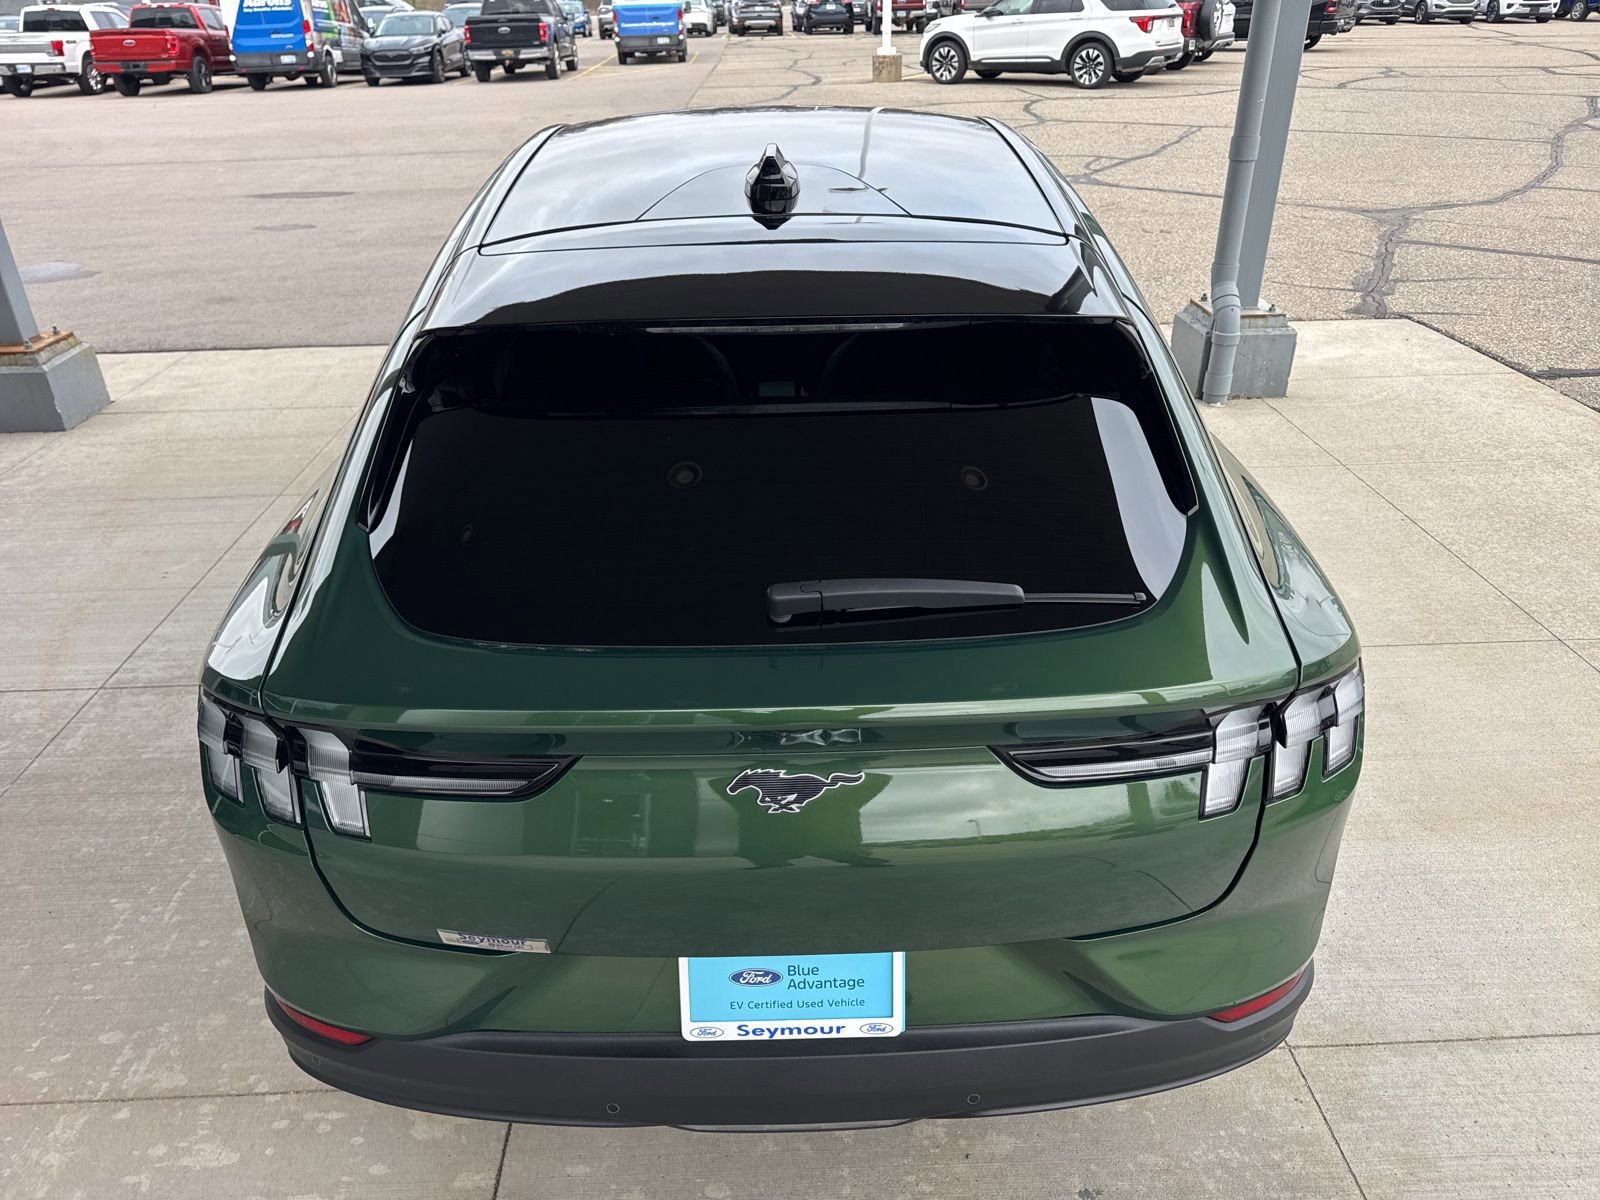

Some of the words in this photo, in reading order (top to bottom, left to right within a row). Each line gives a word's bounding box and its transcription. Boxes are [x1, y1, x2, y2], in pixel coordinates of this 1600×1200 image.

[740, 970, 772, 984] Ford
[787, 964, 820, 977] Blue
[787, 978, 866, 991] Advantage
[730, 1001, 744, 1010] EV
[747, 1000, 793, 1010] Certified
[796, 999, 824, 1009] Used
[827, 997, 866, 1008] Vehicle
[696, 1028, 717, 1037] Ford
[737, 1023, 847, 1039] Seymour
[866, 1024, 887, 1033] Ford
